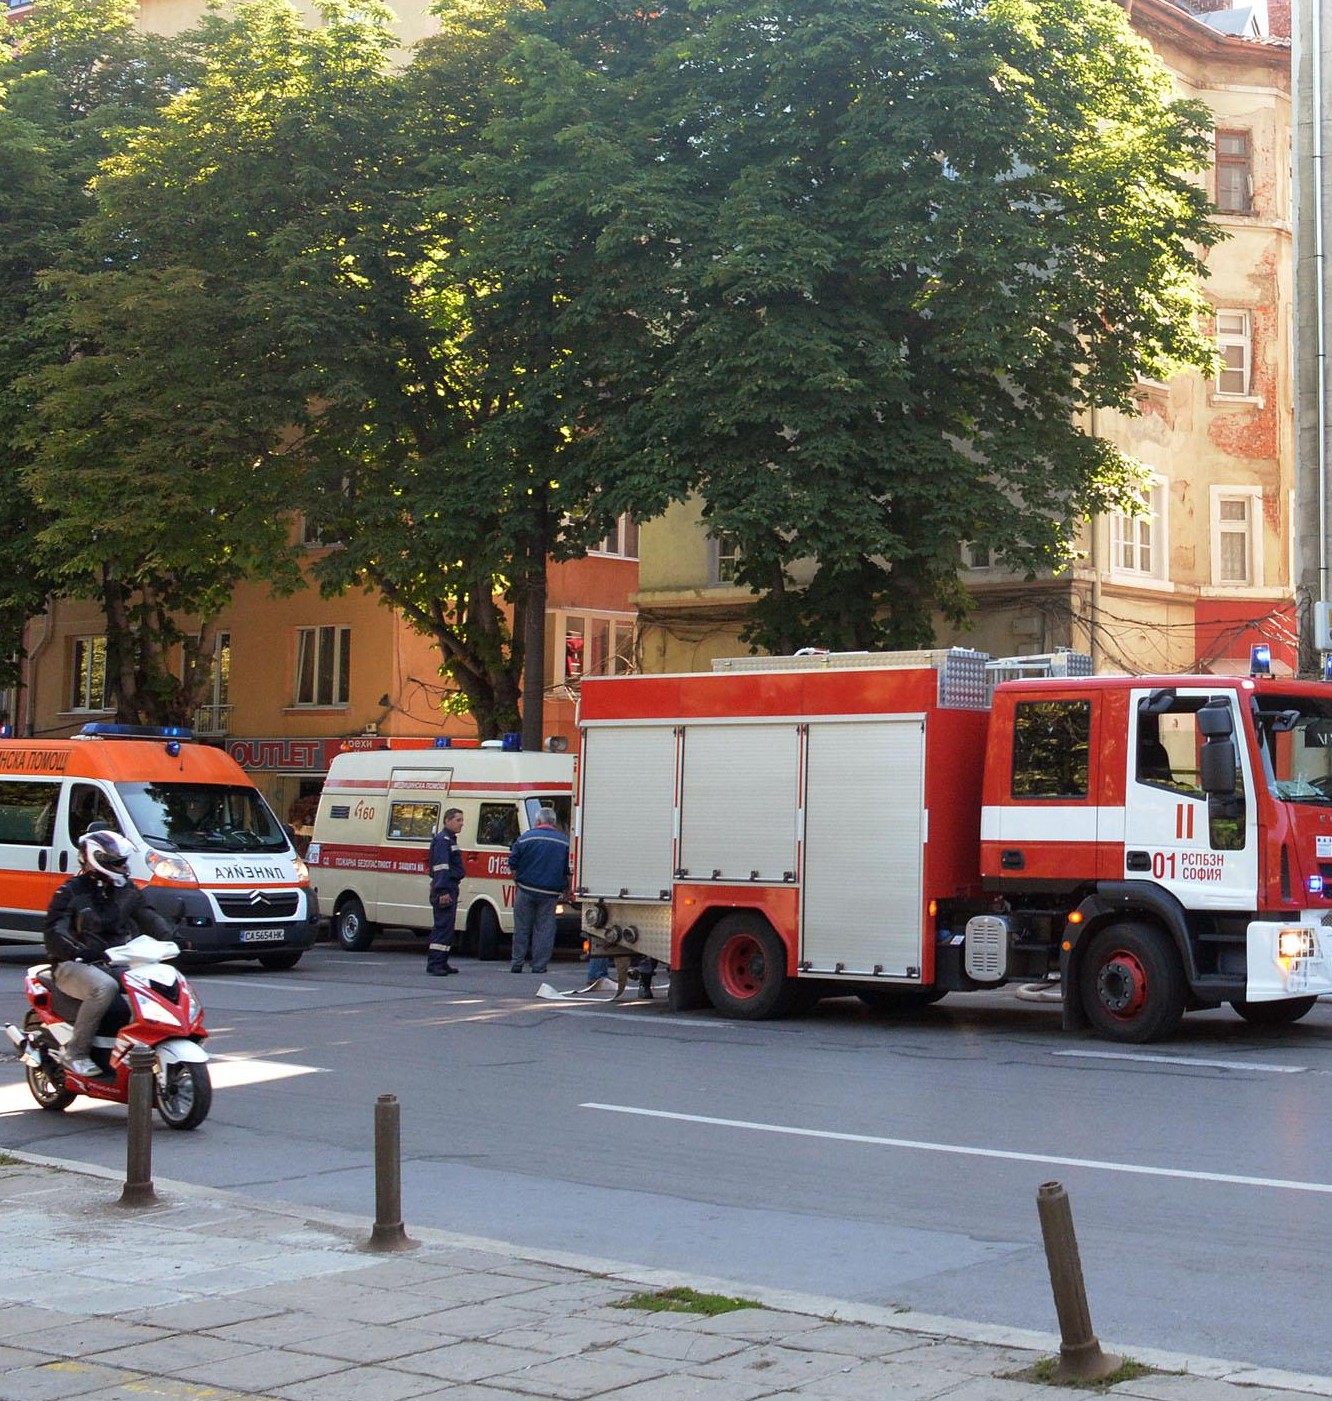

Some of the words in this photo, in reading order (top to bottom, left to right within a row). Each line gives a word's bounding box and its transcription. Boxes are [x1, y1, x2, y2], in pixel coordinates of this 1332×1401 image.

[26, 751, 69, 771] ПОМОЩ
[230, 741, 320, 768] OUTLET
[358, 807, 375, 820] 160
[488, 856, 499, 874] 01
[1152, 851, 1176, 880] 01
[1181, 853, 1224, 867] РСПБЗН
[1182, 867, 1222, 881] СОФИЯ
